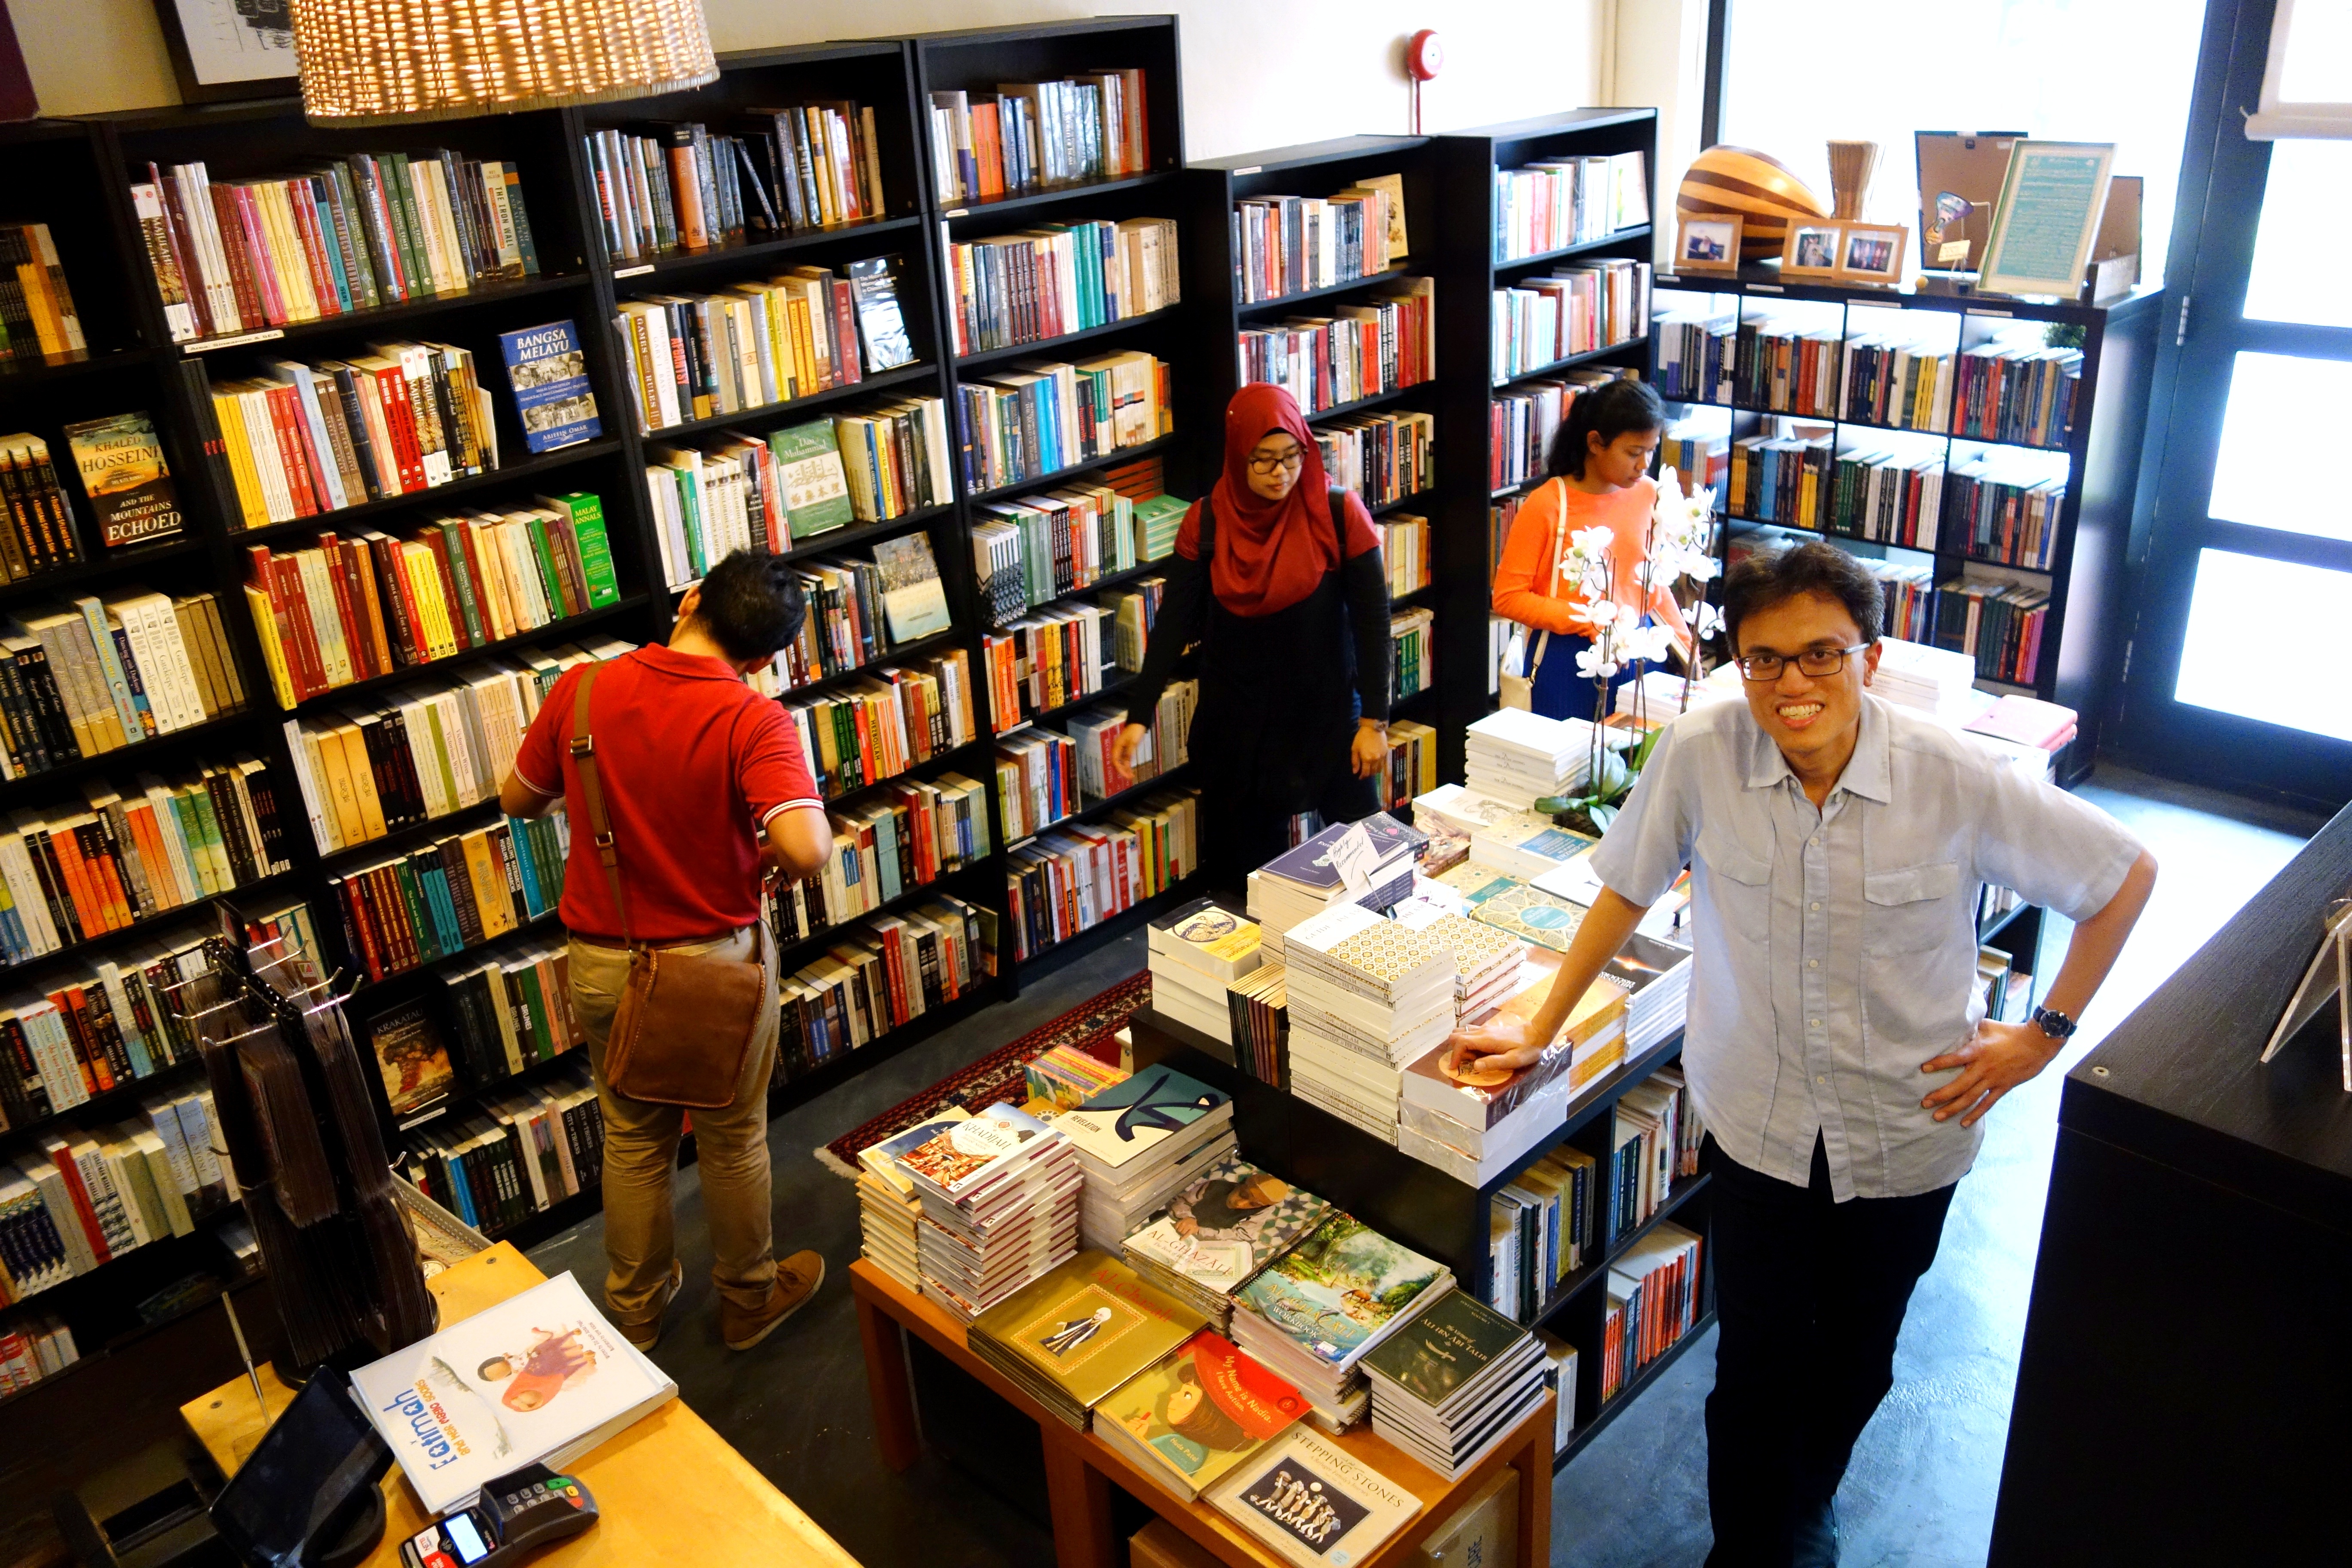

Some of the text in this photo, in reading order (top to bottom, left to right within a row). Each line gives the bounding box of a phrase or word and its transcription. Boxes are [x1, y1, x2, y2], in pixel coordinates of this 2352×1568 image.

[495, 186, 513, 248] THE IRON WALL
[434, 234, 442, 253] Wives
[517, 329, 567, 350] BANGSA
[815, 313, 825, 344] AFGHANISTAN
[520, 340, 570, 361] MELAYU
[635, 317, 648, 353] GAMES
[645, 375, 657, 408] RULES
[652, 336, 662, 359] GARY
[658, 374, 667, 394] BASS
[380, 377, 389, 387] POH
[393, 374, 401, 384] POH
[543, 425, 588, 441] ARIFFIN OMAR
[1078, 407, 1087, 442] humanity
[1087, 404, 1097, 439] humanity
[83, 445, 159, 472] HOSSEINI
[95, 437, 141, 452] KHALED
[289, 427, 307, 487] Squatters into Citizens
[785, 439, 827, 459] Muhammad
[799, 438, 814, 447] Dao
[277, 429, 296, 489] Squatters into Citizens
[883, 468, 892, 501] MODERNISTS
[110, 502, 172, 522] MOUNTAINS
[120, 494, 155, 508] AND THE
[575, 505, 597, 517] MALAY
[707, 492, 717, 532] INGLORIOUS
[108, 511, 181, 541] ECHOED
[575, 512, 601, 525] ANNALS
[458, 561, 469, 587] KAMPUNG
[118, 636, 141, 693] Dancing with Darkness
[141, 659, 159, 697] Gatekeeper
[157, 654, 175, 691] Gatekeeper
[174, 650, 191, 686] Gatekeeper
[444, 731, 460, 777] Victorious Wives
[456, 729, 470, 774] Victorious Wives
[870, 720, 880, 760] HEZBOLLAH
[499, 838, 516, 892] MUSLIMS MATRIARCHS
[505, 836, 521, 890] MUSLIMS MATRIARCHS
[1333, 836, 1364, 870] Highly Recommended
[1305, 908, 1363, 940] GUIDE ISLAM
[376, 1008, 424, 1033] KRAKATAU
[510, 1006, 521, 1032] BRUNEI
[521, 1004, 532, 1030] BRUNEI
[1317, 1012, 1358, 1035] GUIDE ISLAM
[1319, 1022, 1359, 1044] GUIDE ISLAM
[1323, 1087, 1341, 1098] GUIDE
[1346, 1098, 1364, 1110] ISLAM
[1323, 1096, 1341, 1108] GUIDE
[1345, 1107, 1363, 1119] ISLAM
[1070, 1115, 1102, 1133] REVELATION
[1323, 1105, 1363, 1128] GUIDE ISLAM
[1091, 1268, 1177, 1323] Al-Ghazali
[1272, 1306, 1320, 1338] WORKBOOK
[1276, 1301, 1288, 1310] Book
[1316, 1326, 1337, 1341] Children
[1421, 1318, 1488, 1361] ALI IBN ABI TALIB
[1218, 1375, 1228, 1390] have
[1225, 1390, 1244, 1412] Autism.
[1225, 1355, 1272, 1424] My Name is Nadia.
[383, 1388, 459, 1470] Fatimah
[453, 1439, 471, 1456] and
[1171, 1438, 1199, 1462] Huda Patel
[1291, 1432, 1351, 1475] STEPPING
[1352, 1472, 1404, 1508] STONES
[1315, 1458, 1333, 1473] Refugee
[1351, 1482, 1369, 1497] Journey
